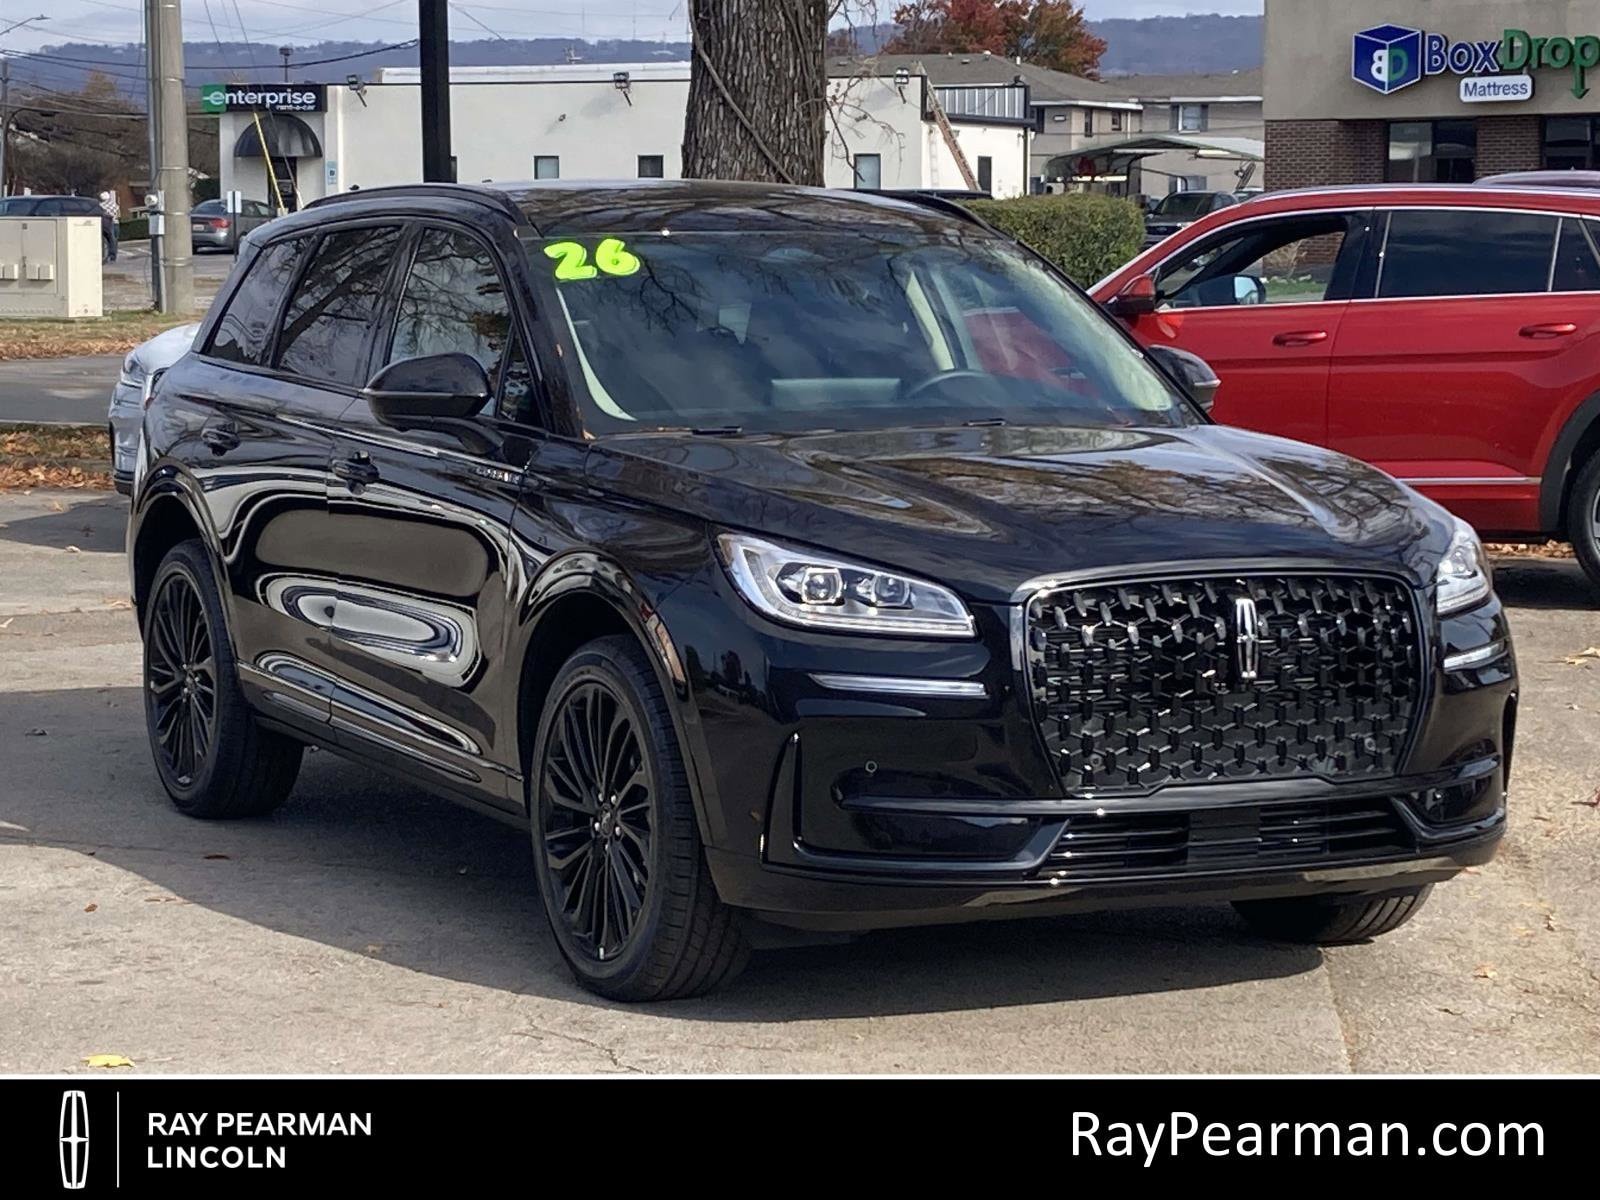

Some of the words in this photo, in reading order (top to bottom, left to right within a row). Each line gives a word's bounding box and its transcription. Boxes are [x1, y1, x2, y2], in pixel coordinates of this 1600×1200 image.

[1424, 28, 1600, 98] BoxDrop
[208, 88, 316, 108] enterprise
[1463, 81, 1528, 97] Mattress
[543, 238, 641, 280] 26
